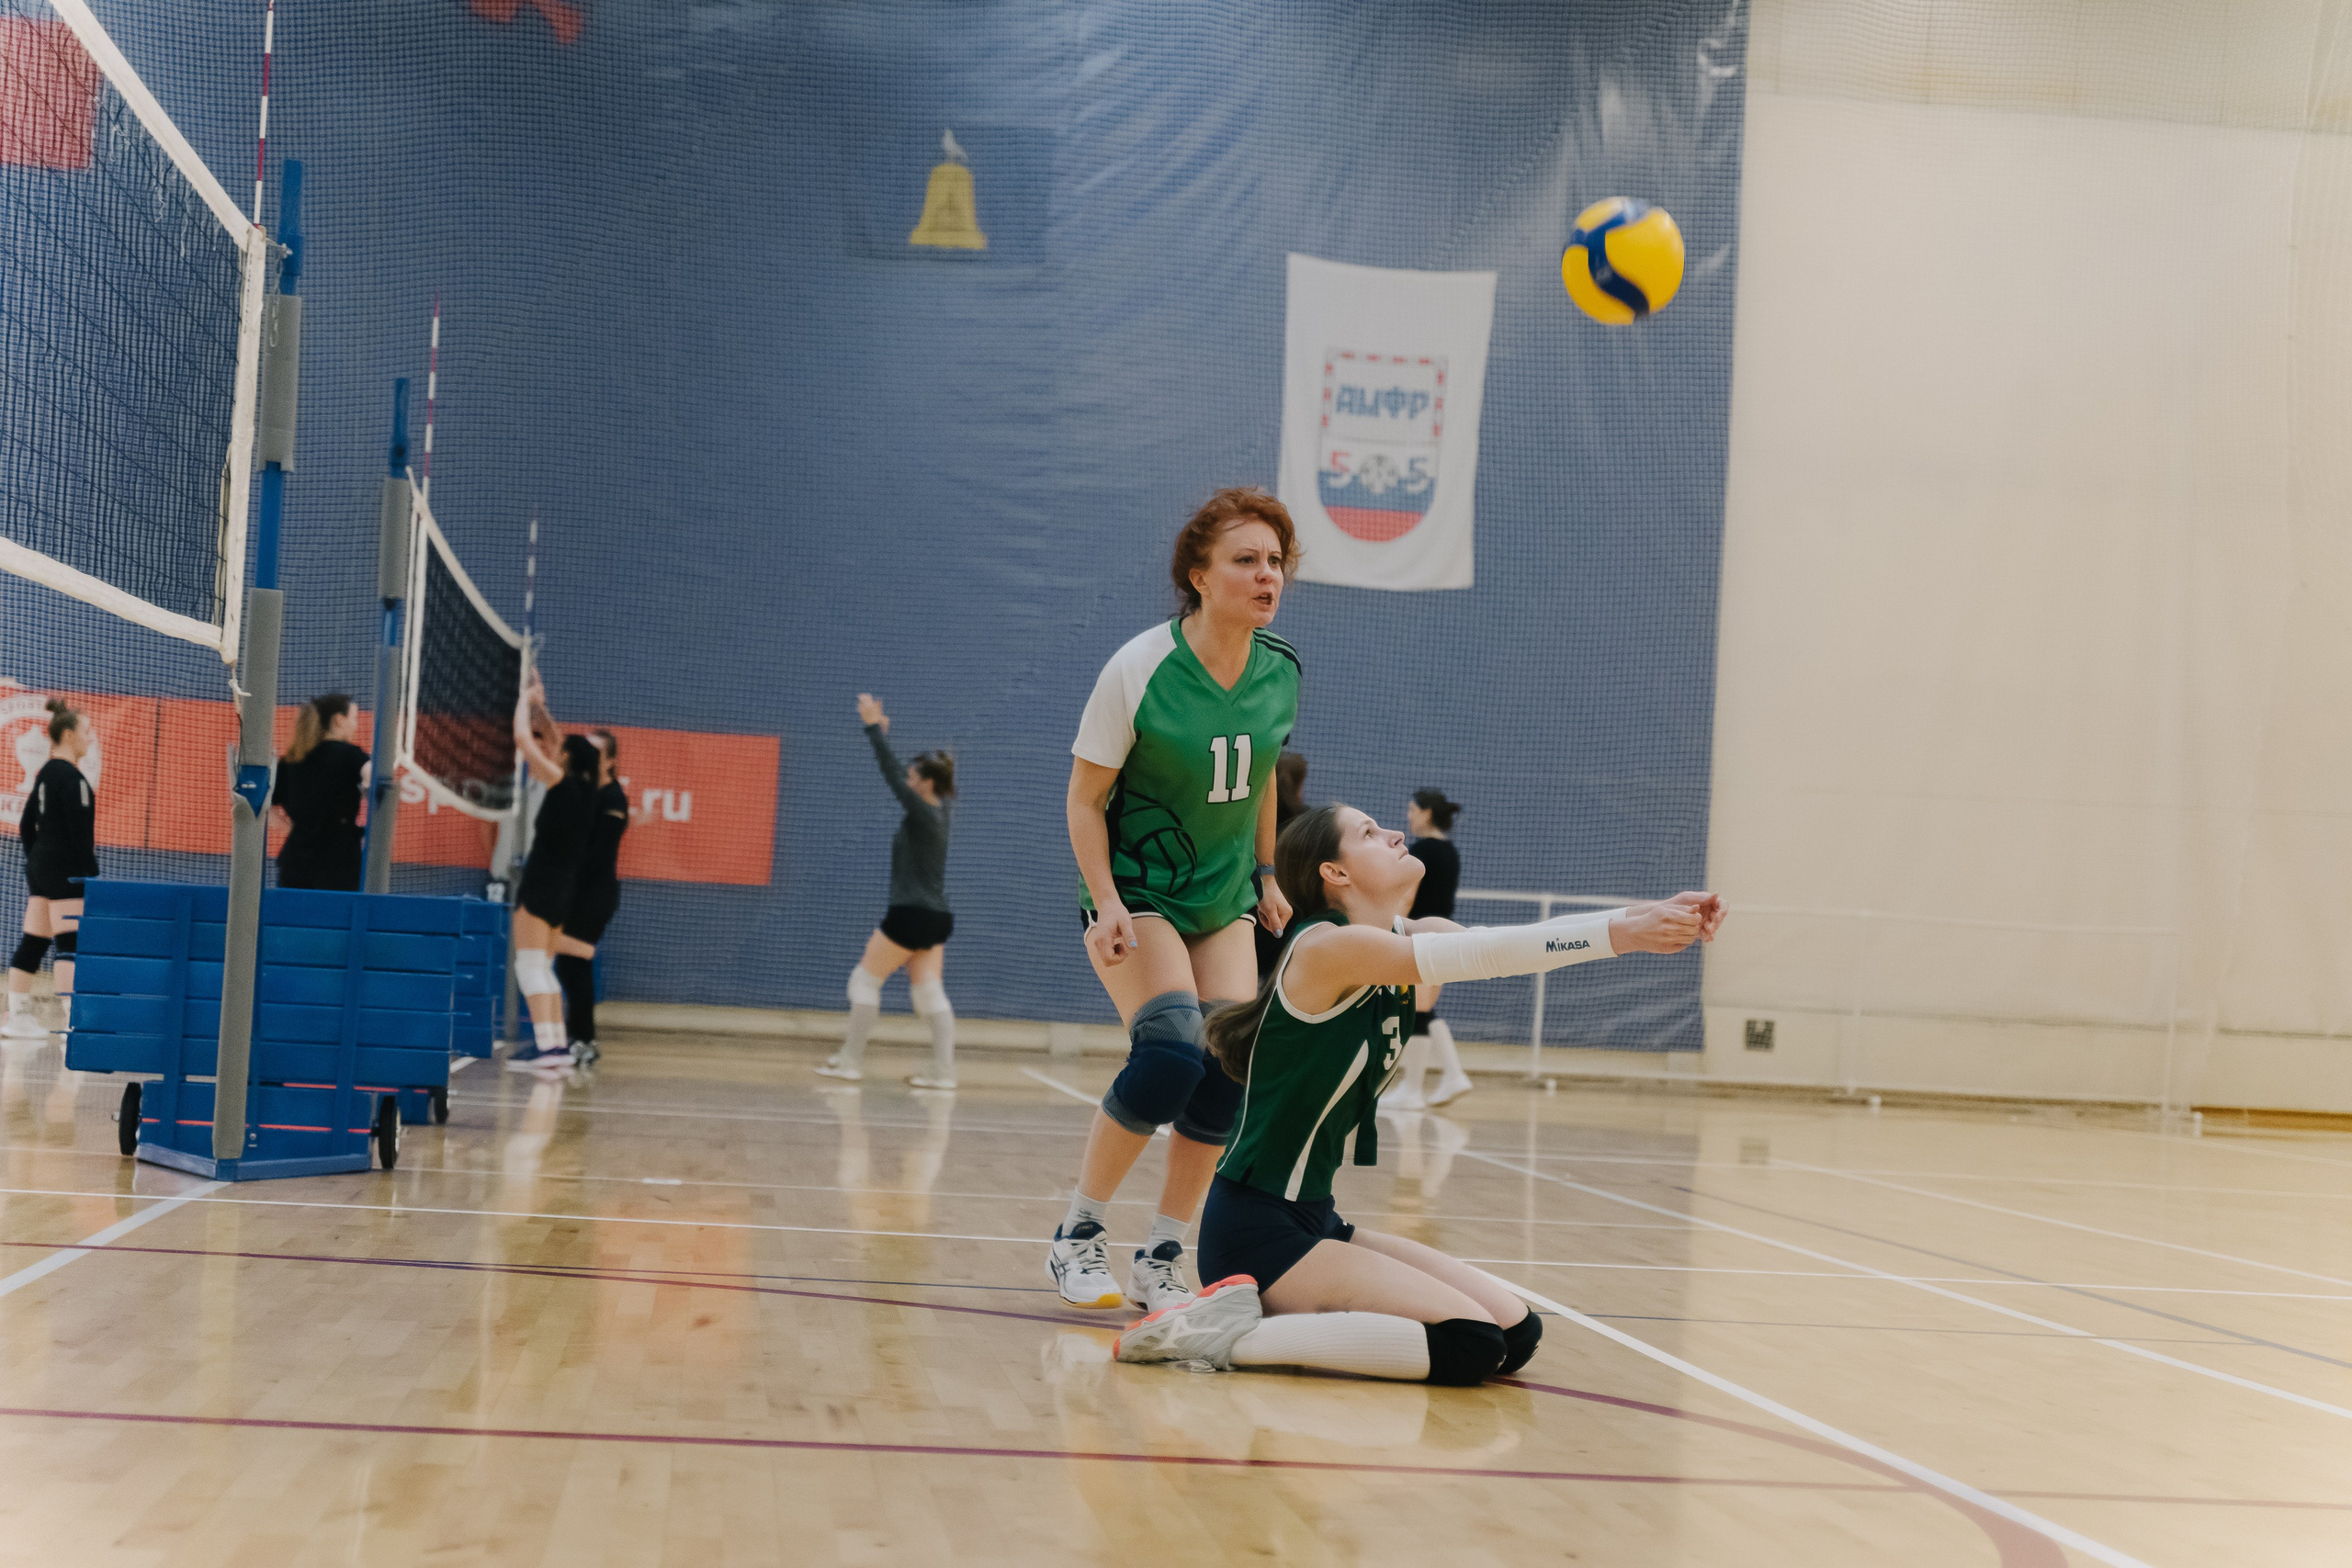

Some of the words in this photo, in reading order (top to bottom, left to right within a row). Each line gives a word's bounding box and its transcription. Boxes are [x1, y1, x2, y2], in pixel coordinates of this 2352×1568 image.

[1207, 733, 1252, 804] 11
[1546, 937, 1590, 953] MIKASA
[1382, 1016, 1403, 1071] 3
